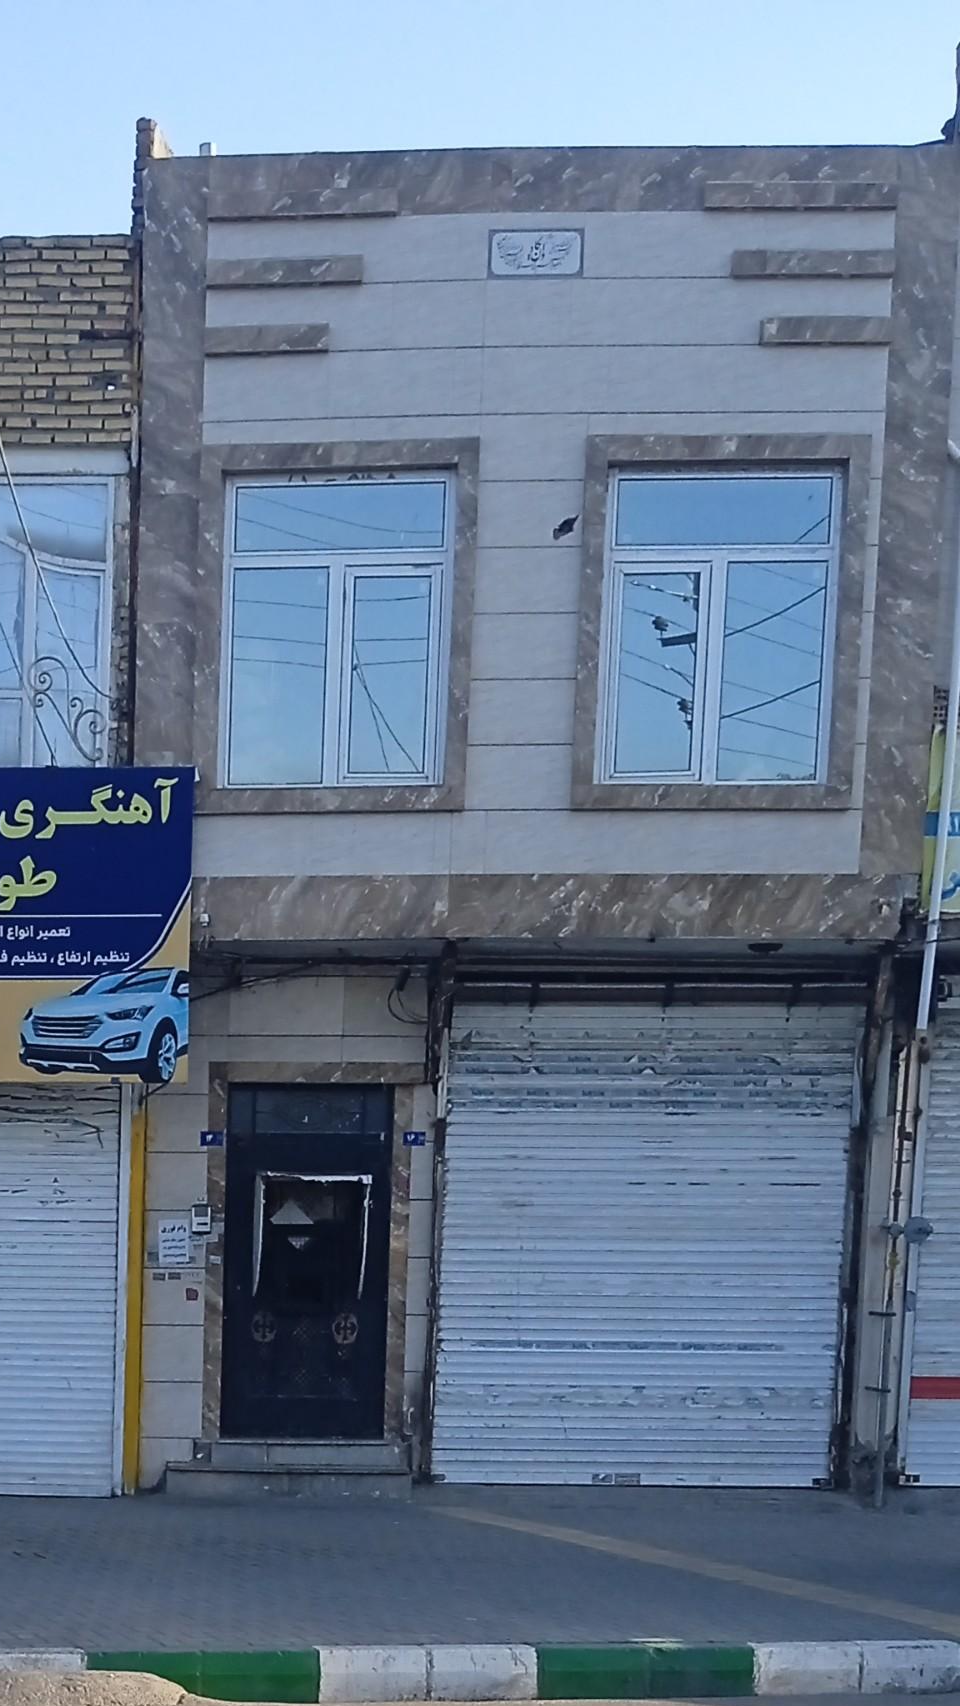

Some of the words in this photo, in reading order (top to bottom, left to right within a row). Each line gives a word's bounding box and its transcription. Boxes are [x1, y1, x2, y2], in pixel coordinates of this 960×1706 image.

[6, 925, 34, 940] انواع
[36, 926, 71, 940] تعمیر
[10, 950, 48, 966] تنظیم
[56, 950, 92, 966] ارتفاع
[93, 950, 130, 966] تنظیم
